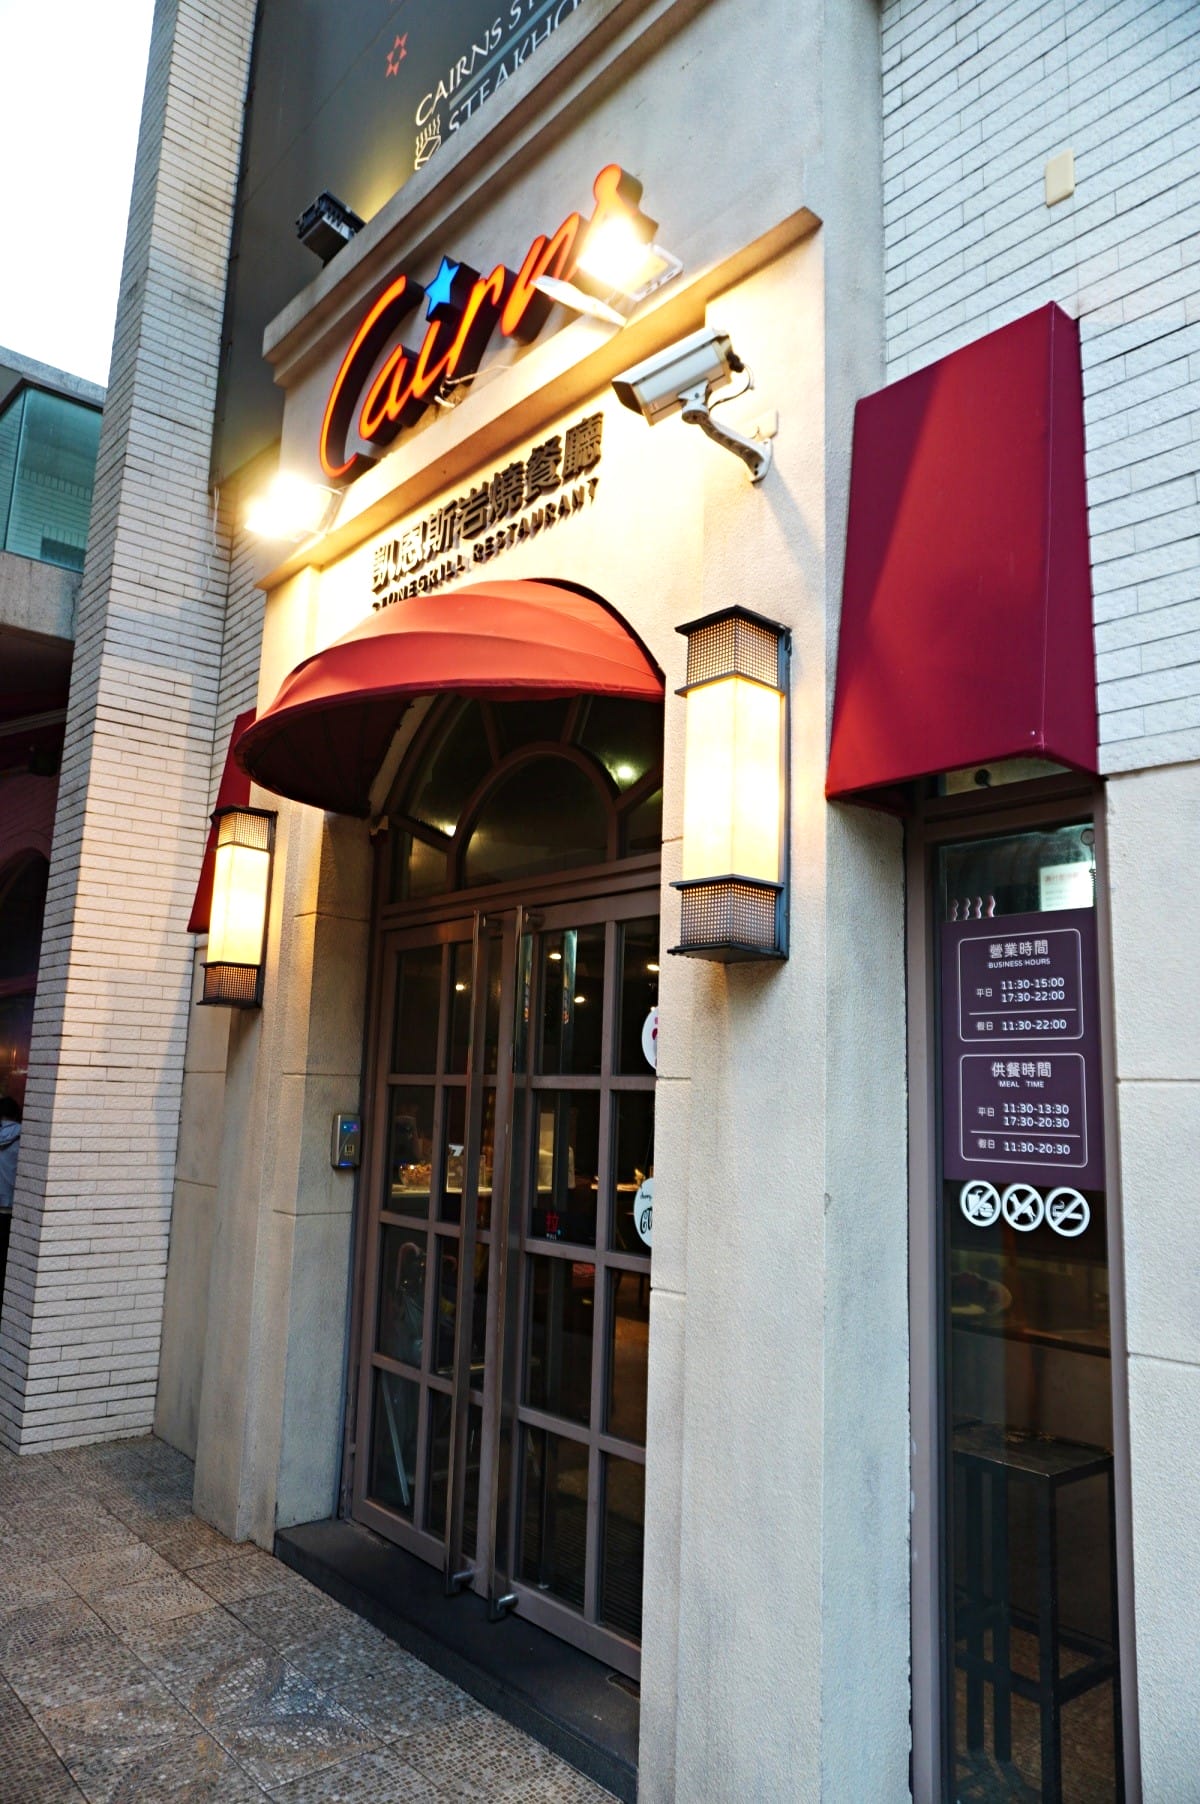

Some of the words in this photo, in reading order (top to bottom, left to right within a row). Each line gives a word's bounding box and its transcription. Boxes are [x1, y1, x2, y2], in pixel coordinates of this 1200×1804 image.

[415, 17, 503, 127] CAIRNS
[319, 163, 655, 480] Cairn
[472, 477, 599, 565] RESTAURANT
[989, 939, 1049, 959] 營業時間
[988, 960, 1023, 969] BUSINESS
[1024, 958, 1051, 967] HOURS
[1001, 977, 1065, 990] 11:30-15:00
[976, 988, 993, 998] 平日
[1001, 990, 1065, 1003] 17:30-22:00
[976, 1021, 994, 1032] 假日
[1002, 1019, 1067, 1031] 11:30-22:00
[991, 1062, 1052, 1078] 供餐時間
[999, 1080, 1020, 1088] MEAL
[1026, 1080, 1045, 1088] TIME
[977, 1107, 995, 1117] 平日
[1003, 1103, 1070, 1115] 11:30-13:30
[1003, 1116, 1070, 1128] 17:30-20:30
[977, 1139, 996, 1149] 假日
[1003, 1142, 1071, 1155] 11:30-20:30
